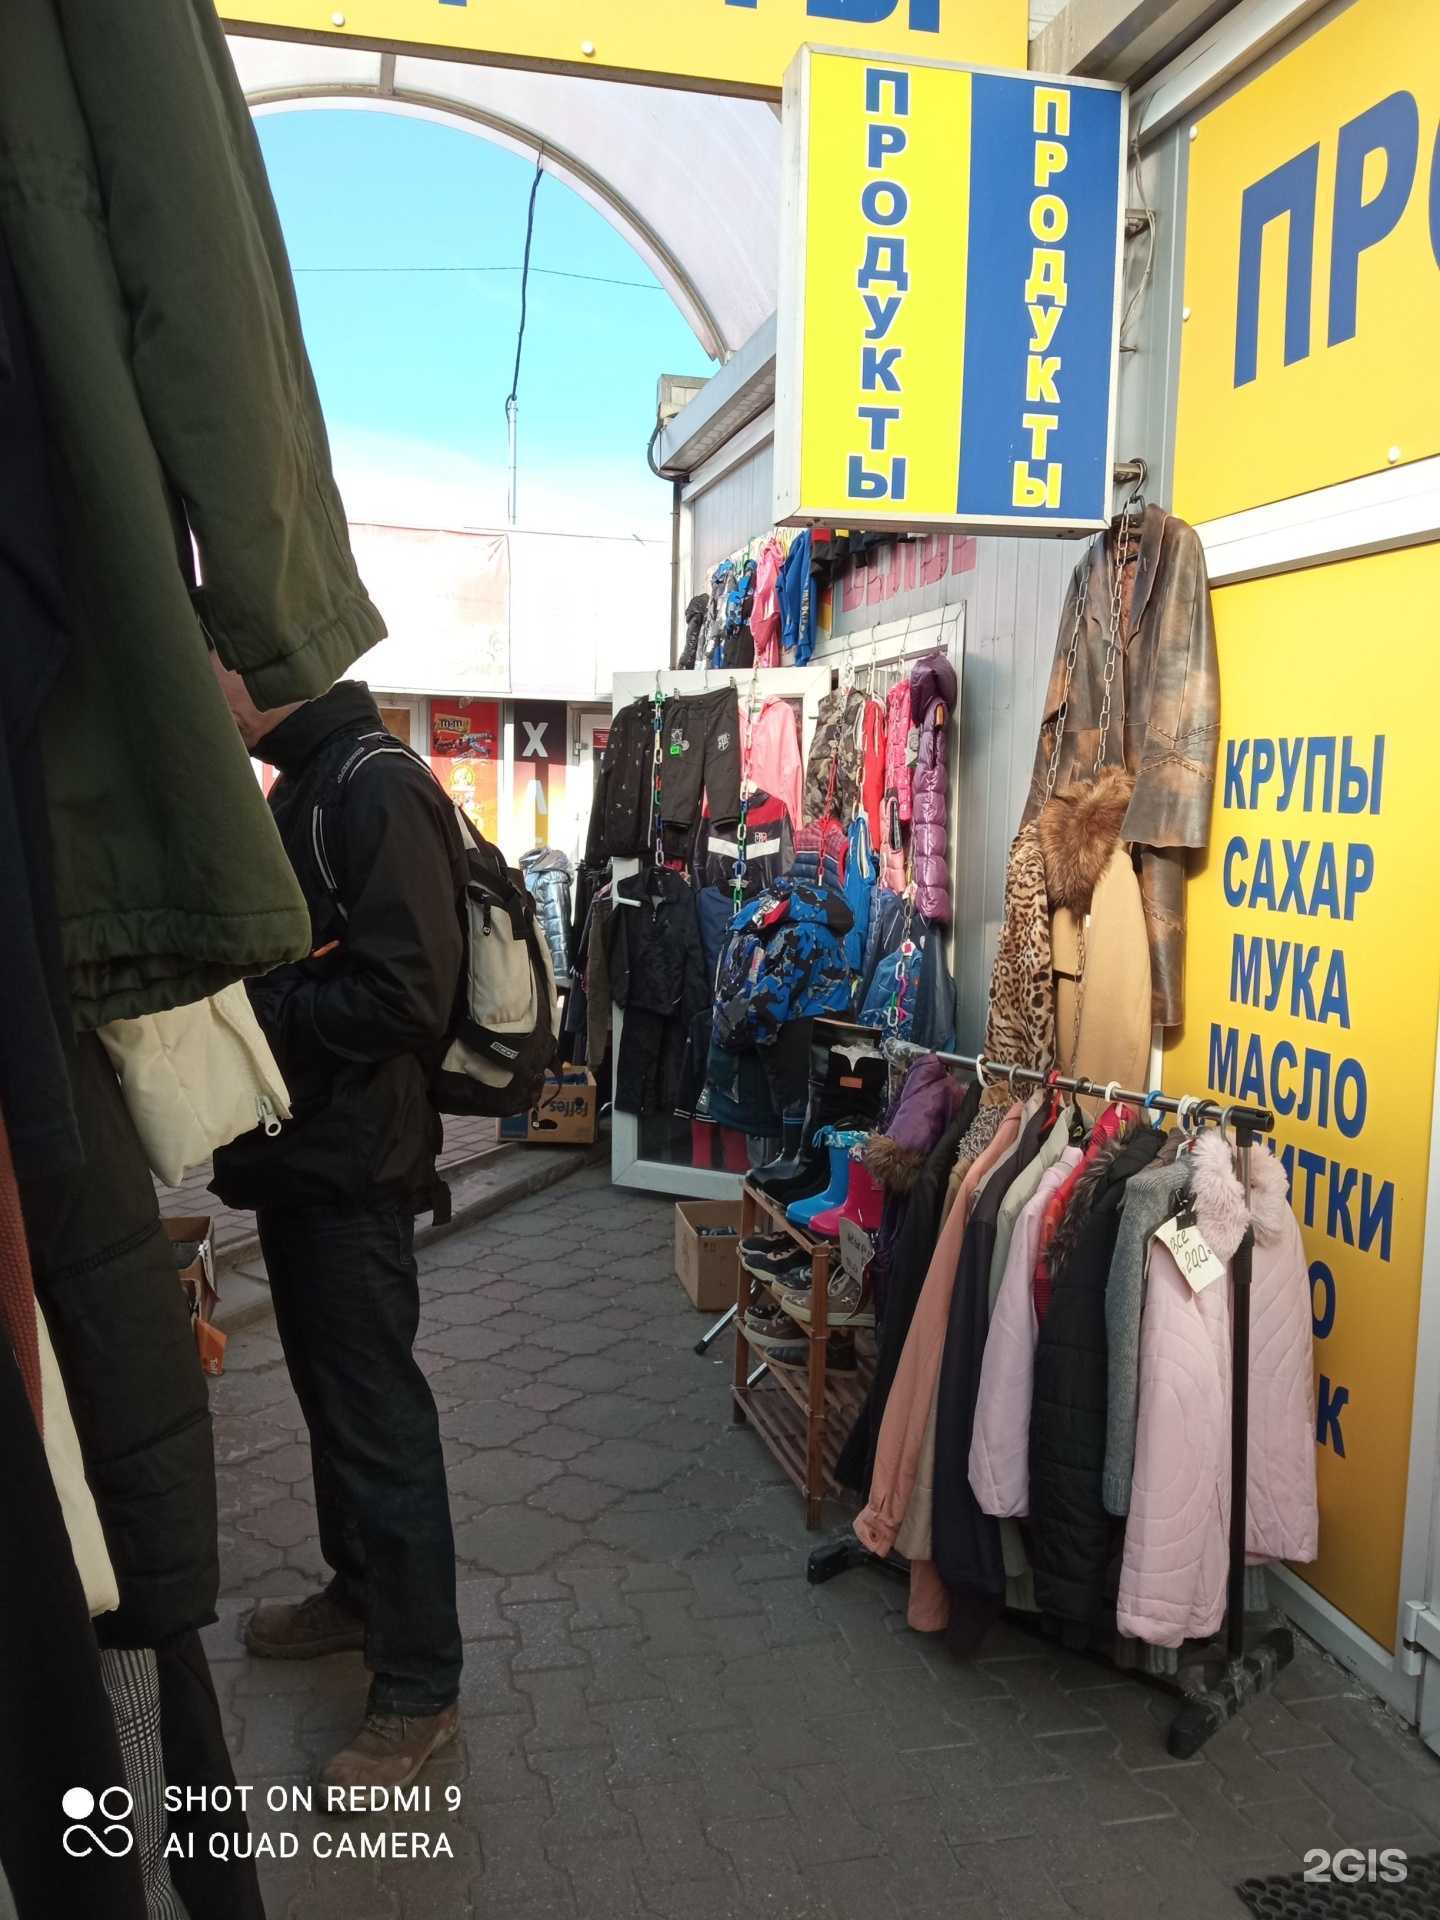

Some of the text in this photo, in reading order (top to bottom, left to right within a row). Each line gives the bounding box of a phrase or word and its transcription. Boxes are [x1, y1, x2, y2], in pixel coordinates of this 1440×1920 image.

[848, 68, 908, 500] ПРОДУКТЫ
[1012, 86, 1070, 508] ПРОДУКТЫ
[1234, 90, 1440, 388] ПР
[1223, 735, 1386, 816] КРУПЫ
[1222, 836, 1375, 921] САХАР
[1229, 933, 1351, 1030] МУКА
[1207, 1022, 1368, 1138] МАСЛО
